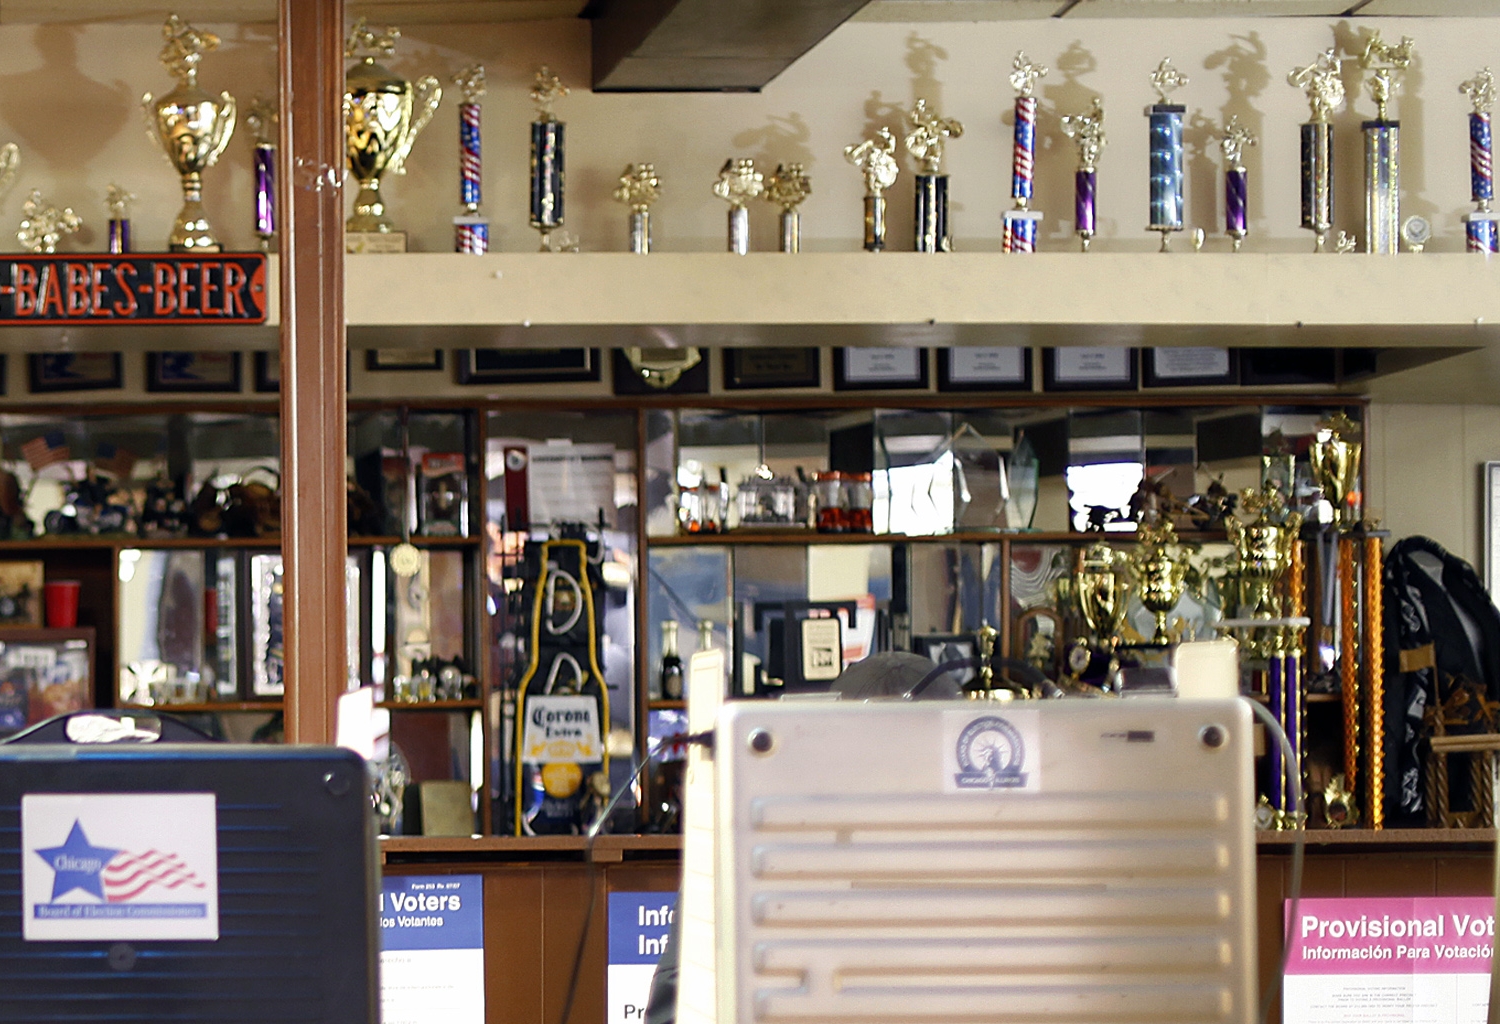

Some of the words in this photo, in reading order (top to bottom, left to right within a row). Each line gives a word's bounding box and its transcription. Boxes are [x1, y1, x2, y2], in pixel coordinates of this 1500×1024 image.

[54, 855, 102, 875] Chicago
[40, 906, 68, 916] Board
[72, 906, 82, 916] of
[85, 906, 123, 916] Election
[127, 906, 203, 916] Commissioners
[390, 893, 461, 912] Voters
[397, 916, 443, 928] Votantes
[1302, 915, 1444, 938] Provisional
[1302, 944, 1392, 960] Información
[1396, 945, 1430, 959] Para
